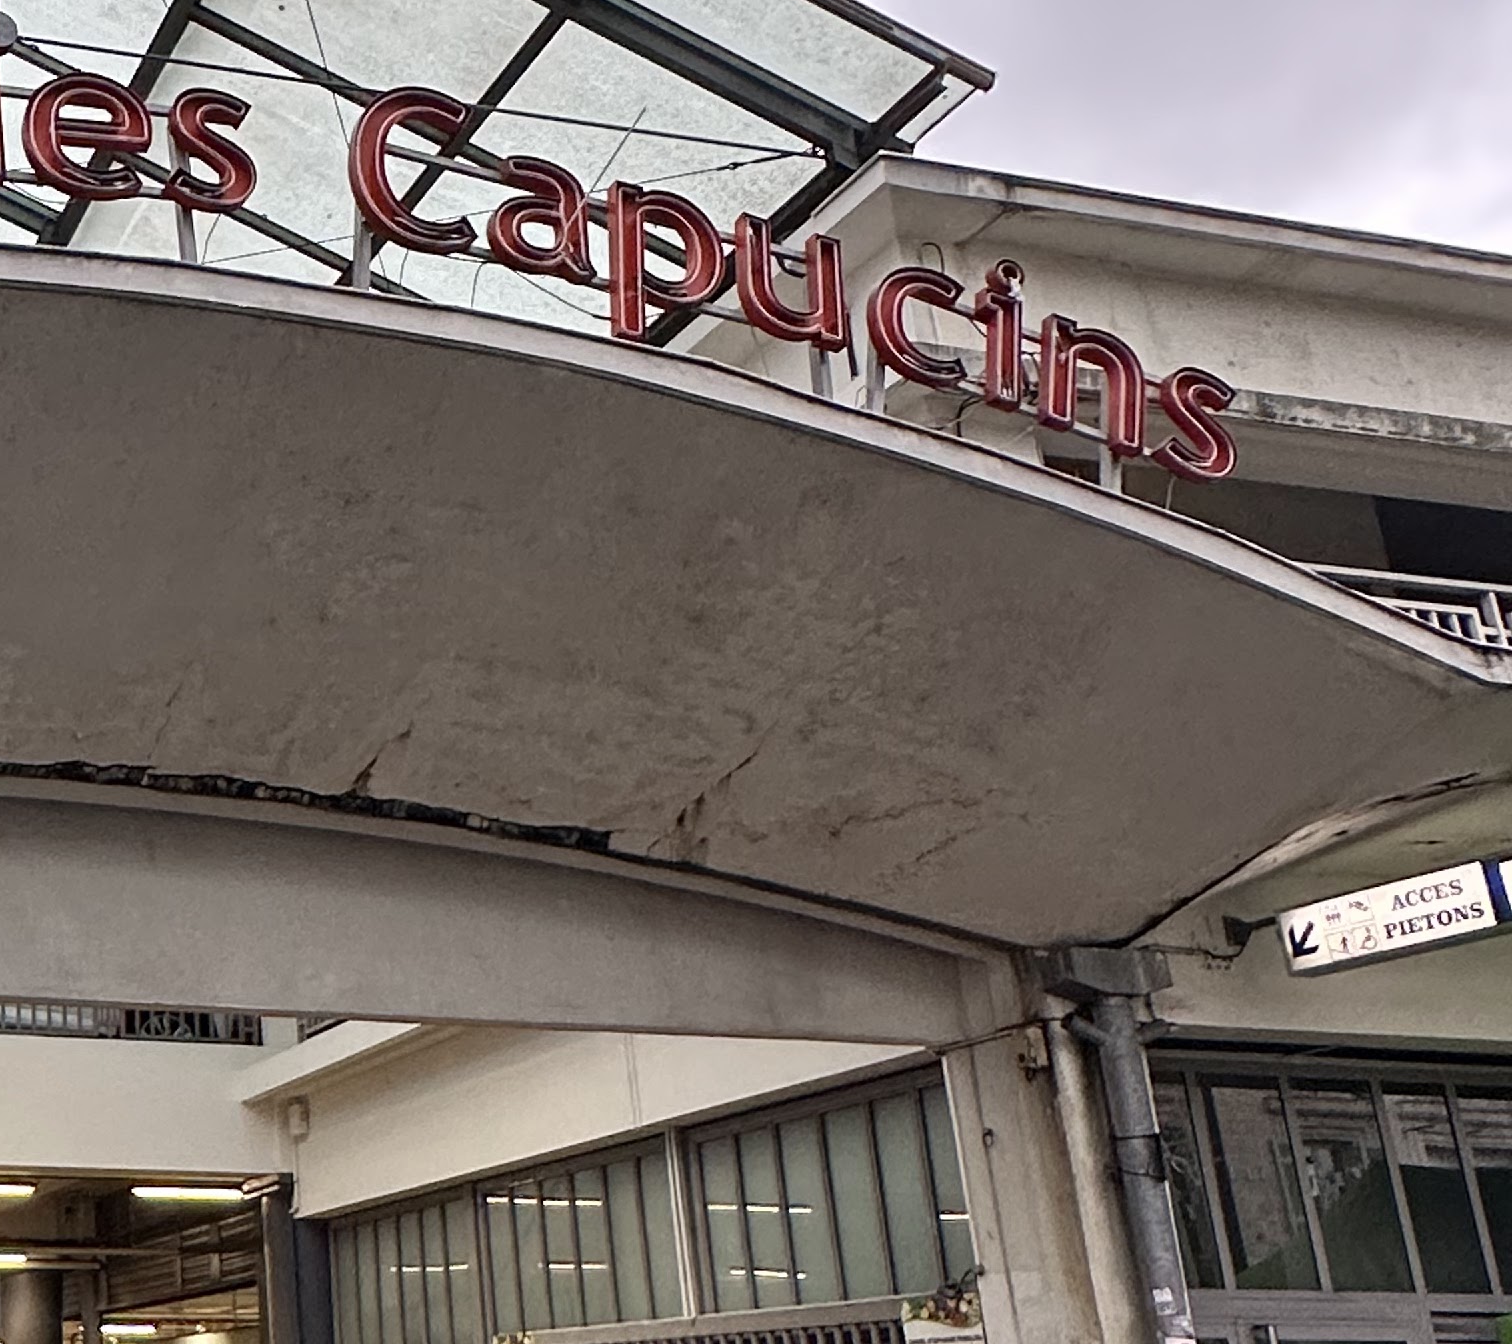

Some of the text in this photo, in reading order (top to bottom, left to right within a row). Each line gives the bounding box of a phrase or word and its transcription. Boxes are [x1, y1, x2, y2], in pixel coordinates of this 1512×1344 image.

[345, 86, 1238, 482] Capucins
[1391, 879, 1464, 912] ACCES
[1384, 901, 1485, 939] PIETONS
